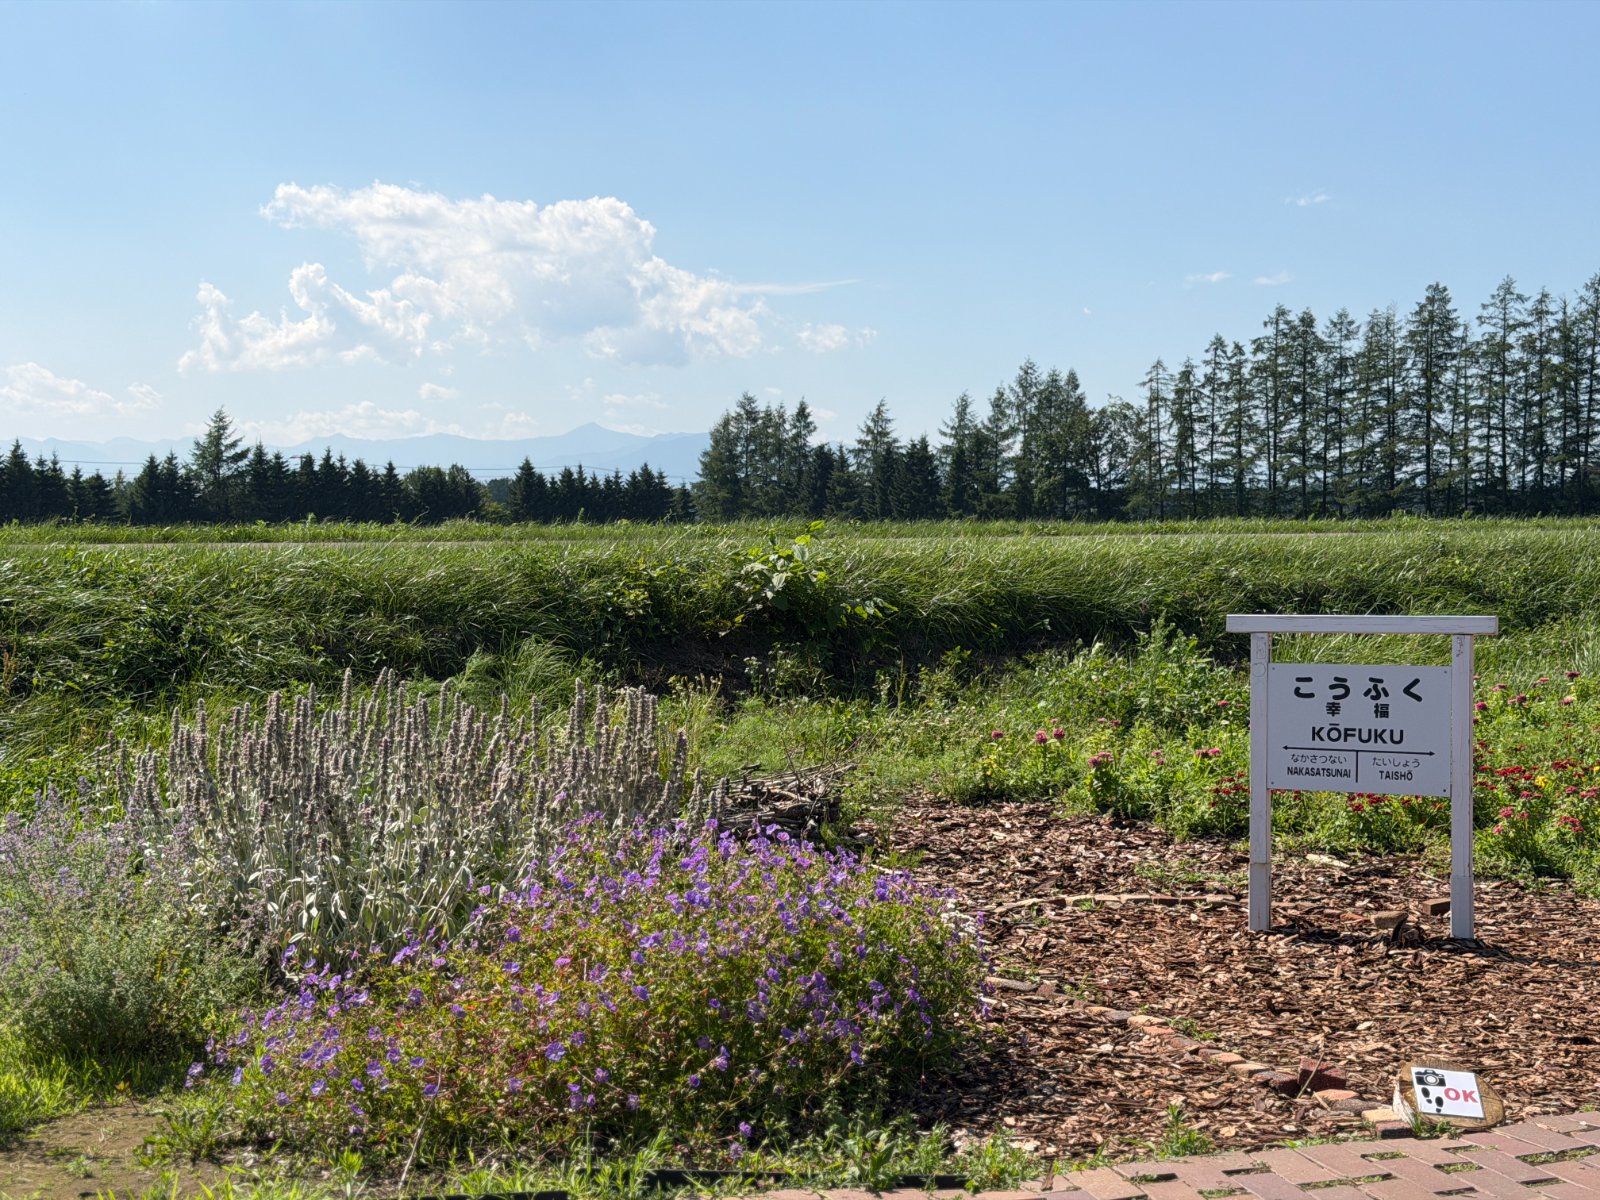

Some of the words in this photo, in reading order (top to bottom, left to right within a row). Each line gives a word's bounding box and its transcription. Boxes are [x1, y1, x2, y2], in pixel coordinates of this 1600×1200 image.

[1293, 676, 1423, 702] こうふく
[1290, 753, 1347, 765] なかさつない
[1372, 756, 1421, 769] たいしょう
[1287, 766, 1351, 779] NAKASATSUNAI
[1444, 1087, 1478, 1103] OK
